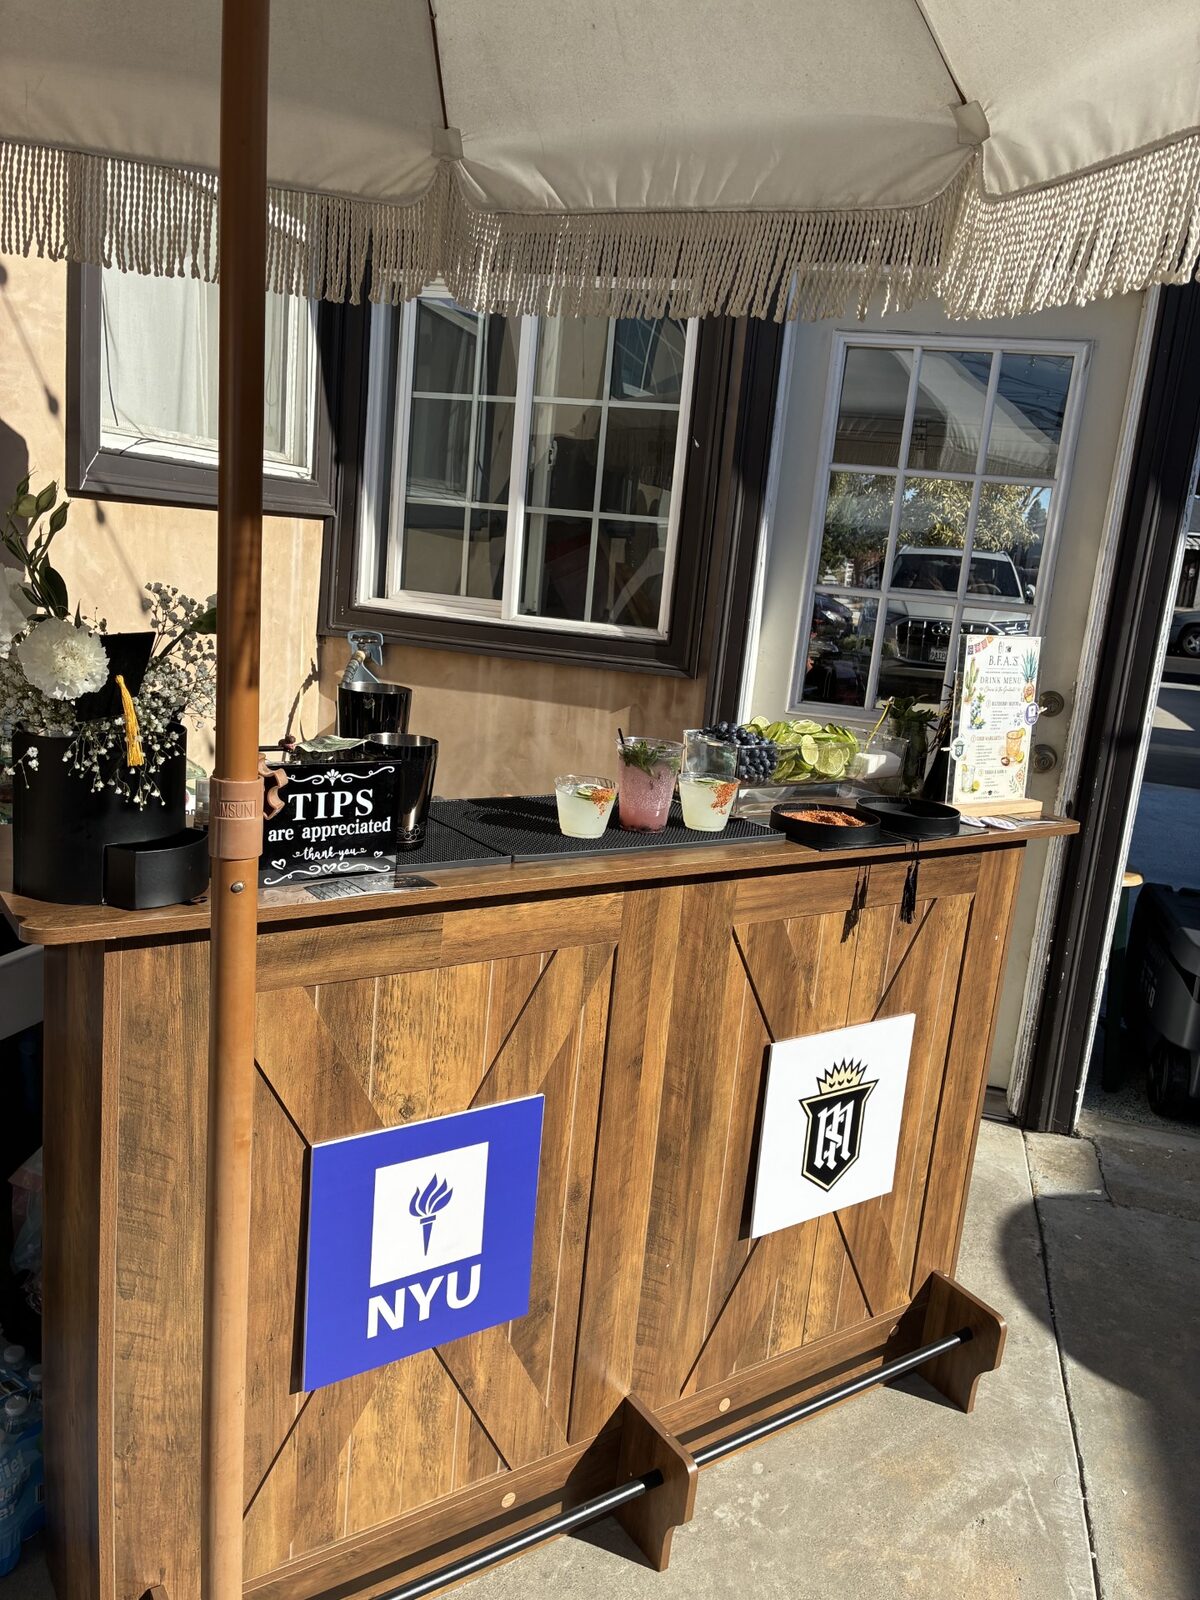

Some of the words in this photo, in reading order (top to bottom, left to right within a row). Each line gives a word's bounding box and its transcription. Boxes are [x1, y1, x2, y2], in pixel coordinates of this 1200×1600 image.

[980, 676, 1001, 685] DRINK
[1003, 676, 1023, 685] MENU
[288, 788, 374, 821] TIPS
[267, 828, 294, 842] are
[301, 816, 391, 843] appreciated
[302, 846, 336, 861] thank
[337, 847, 358, 861] you
[367, 1263, 482, 1339] NYU
